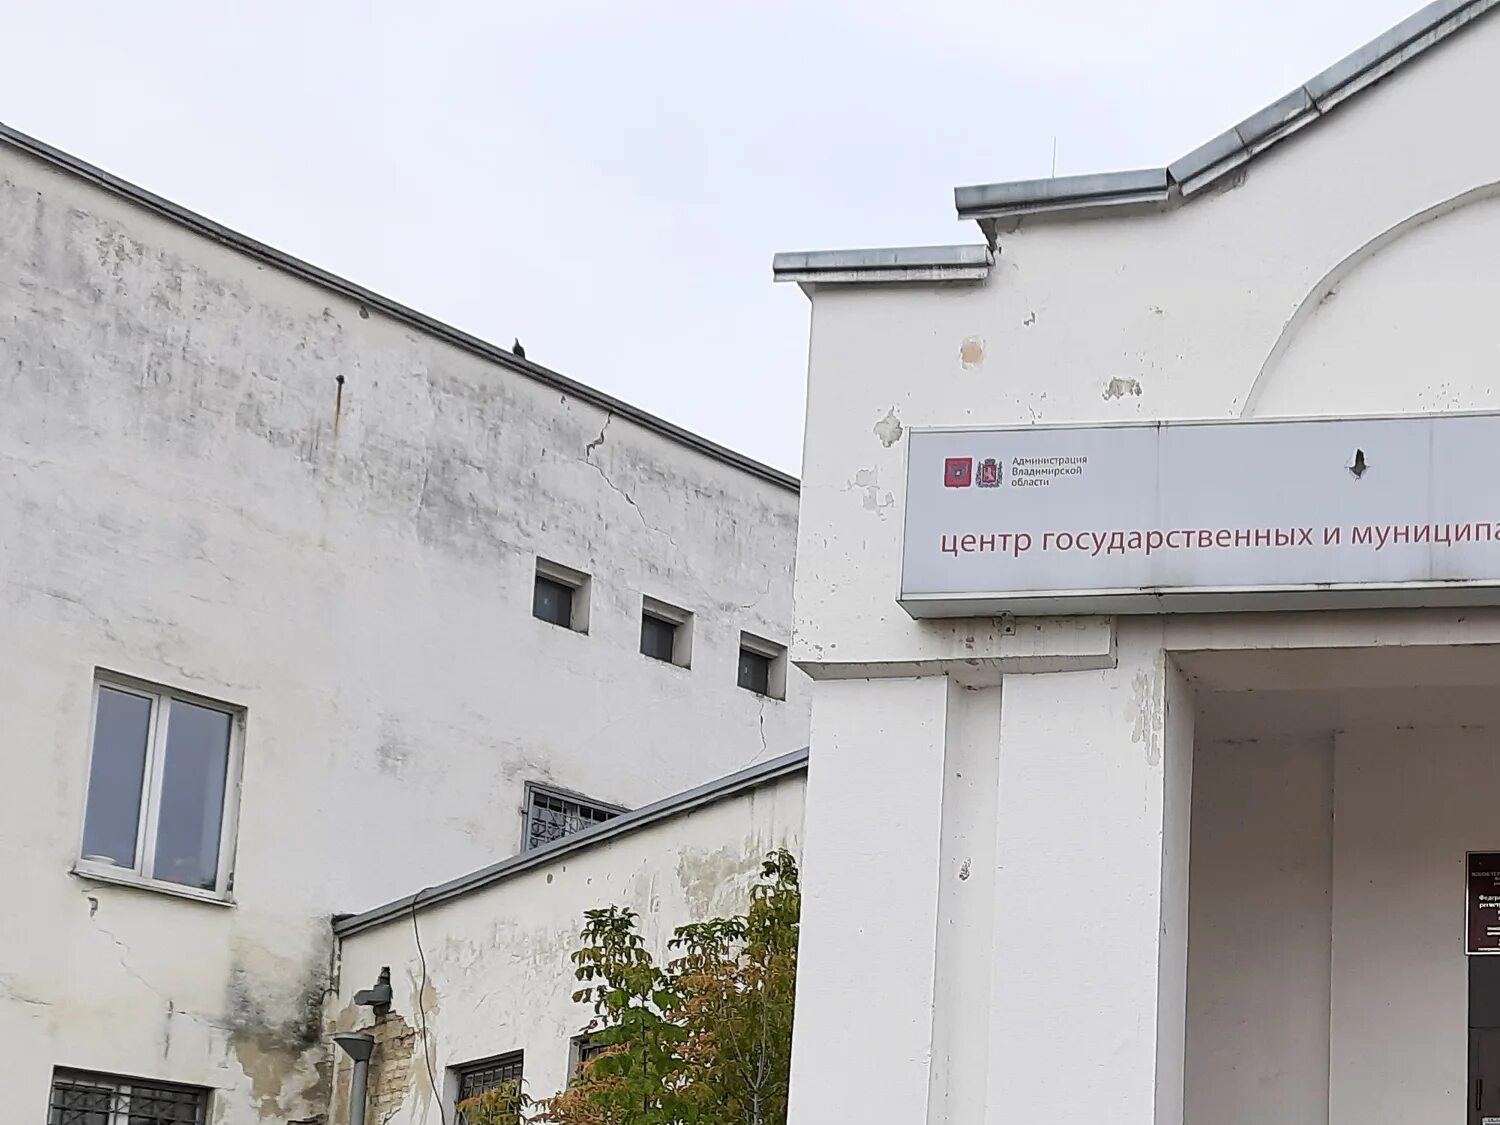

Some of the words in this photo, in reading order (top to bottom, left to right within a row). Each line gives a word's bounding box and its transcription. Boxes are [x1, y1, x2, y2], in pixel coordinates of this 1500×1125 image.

[1012, 456, 1088, 467] Администрация
[1012, 466, 1083, 477] Владимирской
[1011, 477, 1050, 487] области
[940, 532, 1033, 558] центр
[1042, 526, 1314, 558] государственных
[1323, 525, 1342, 545] и
